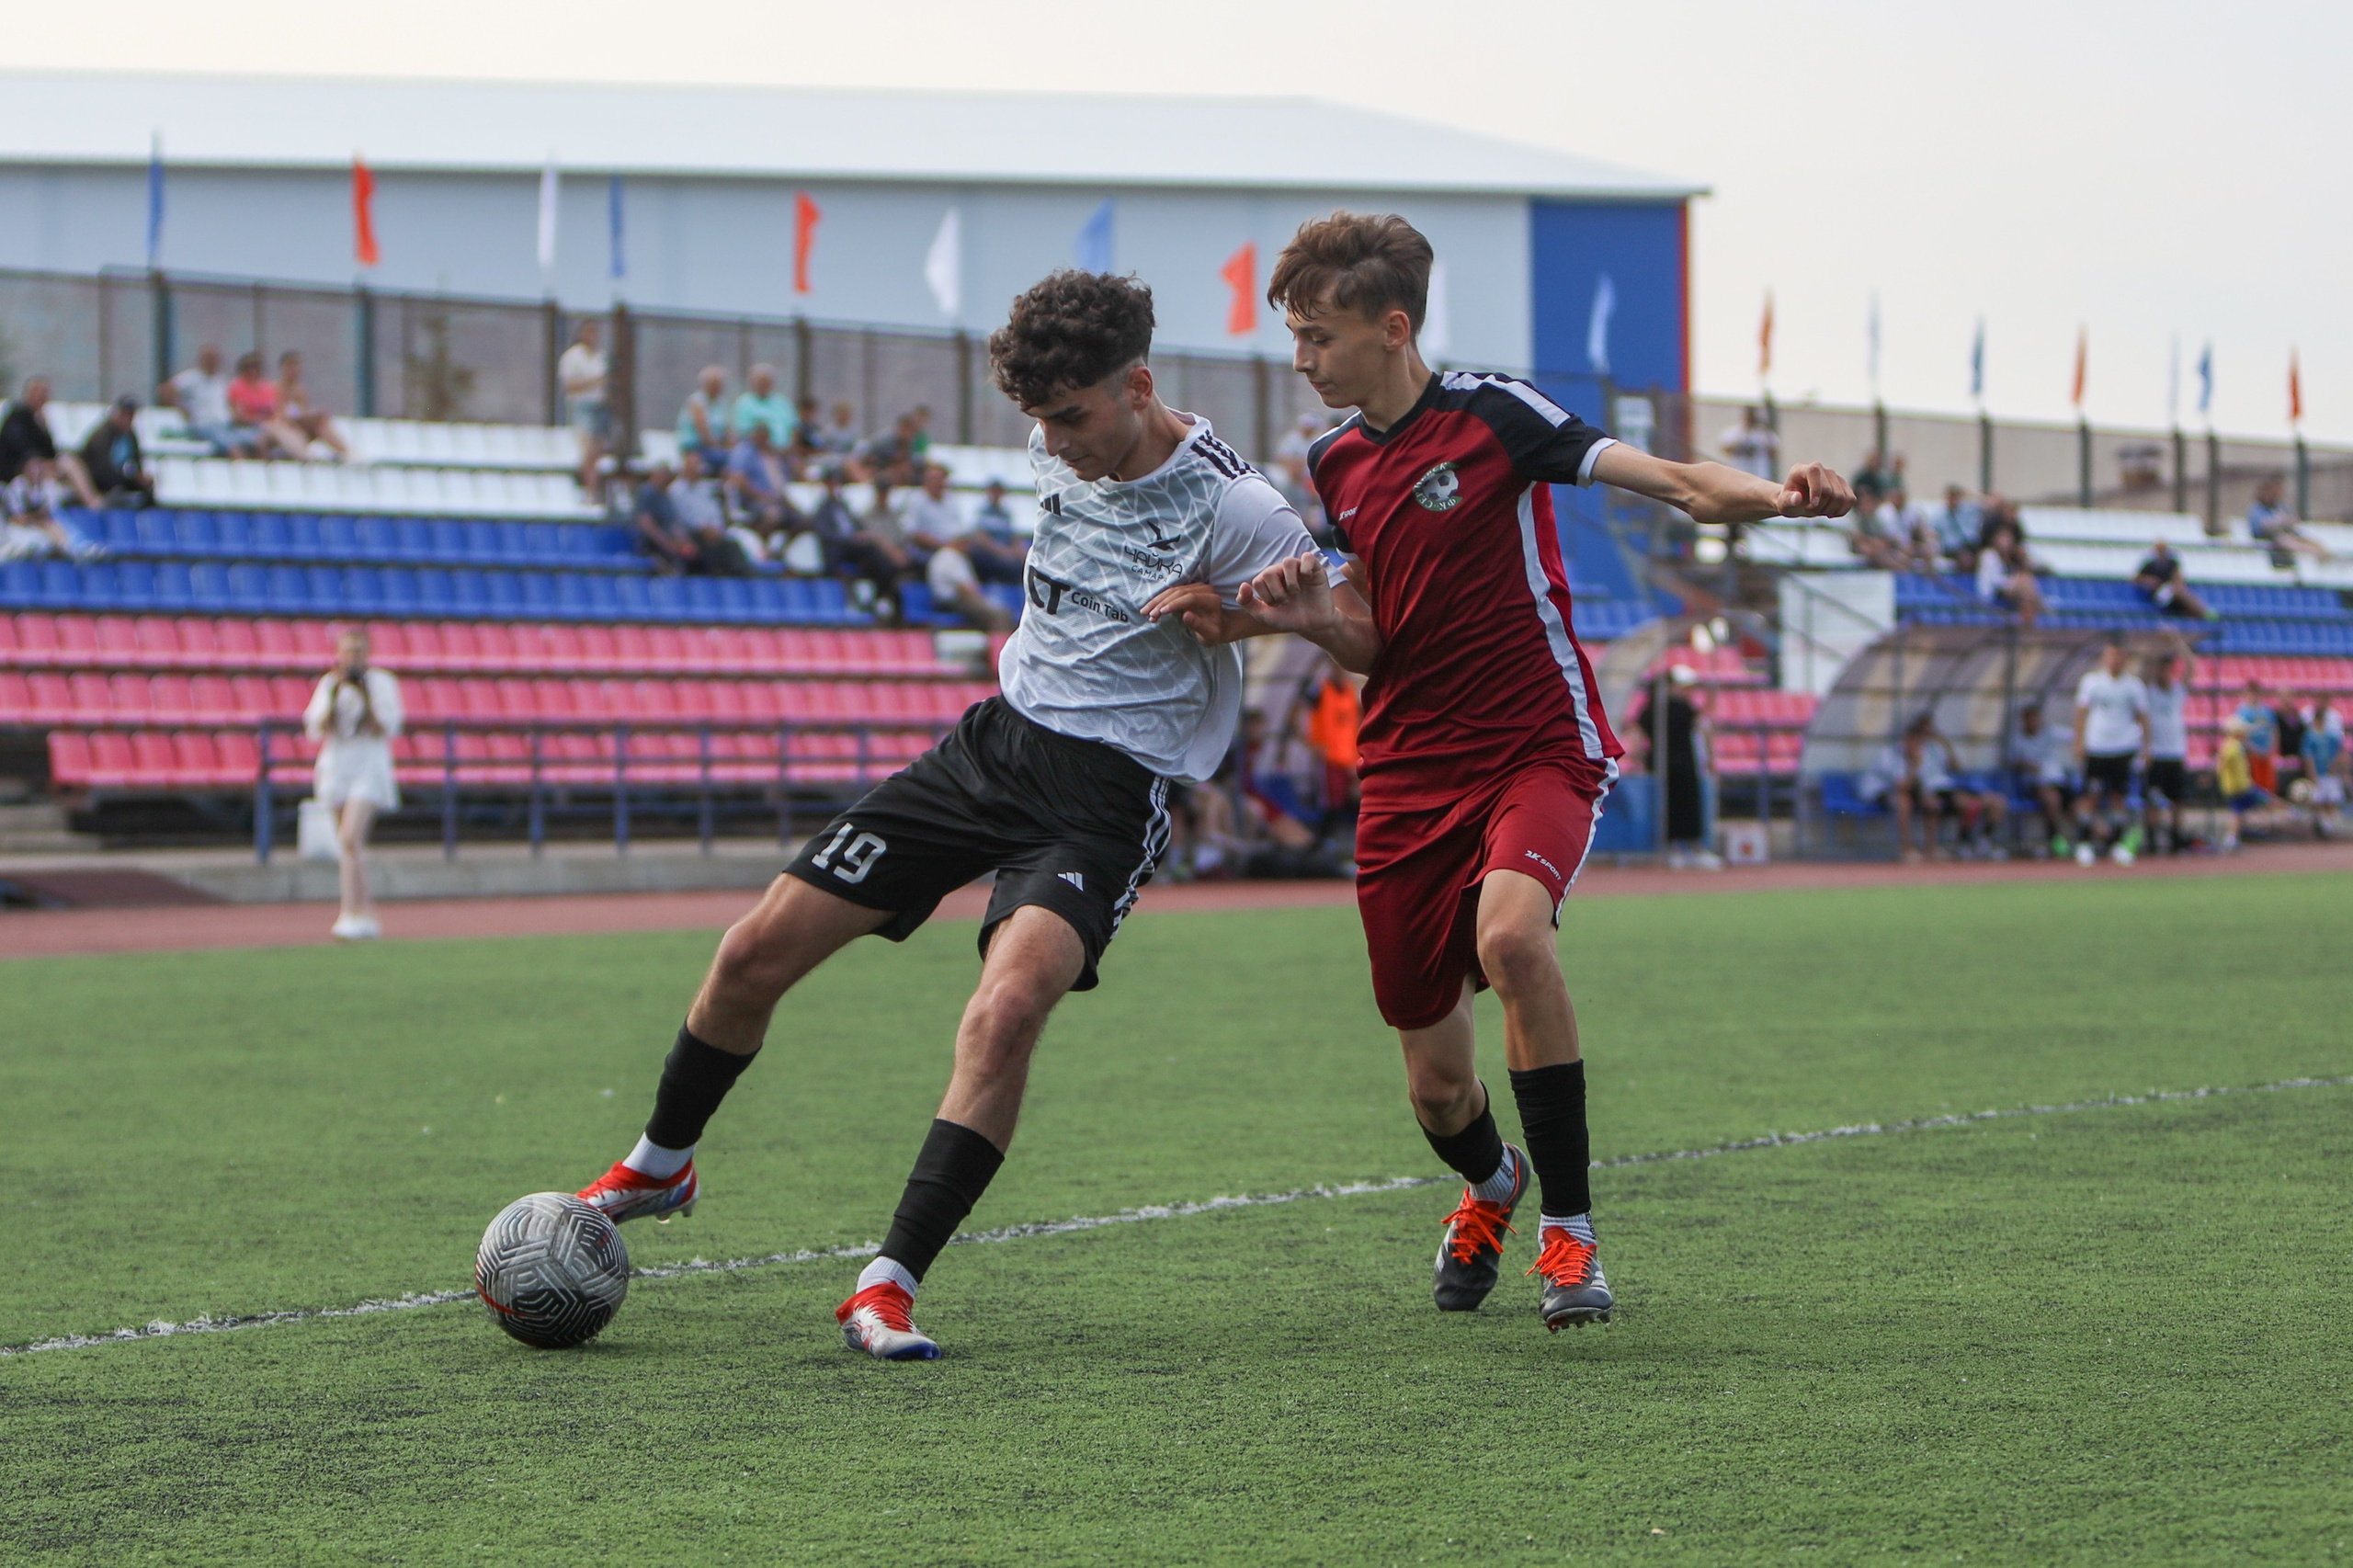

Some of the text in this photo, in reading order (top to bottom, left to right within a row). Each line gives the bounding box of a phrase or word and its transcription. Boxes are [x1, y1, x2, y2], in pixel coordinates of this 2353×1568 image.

[1124, 545, 1183, 578] ЧАЙКА
[1071, 591, 1101, 614] Coin
[1104, 603, 1129, 623] Tab
[811, 822, 887, 884] 19
[1540, 858, 1562, 881] SPORT
